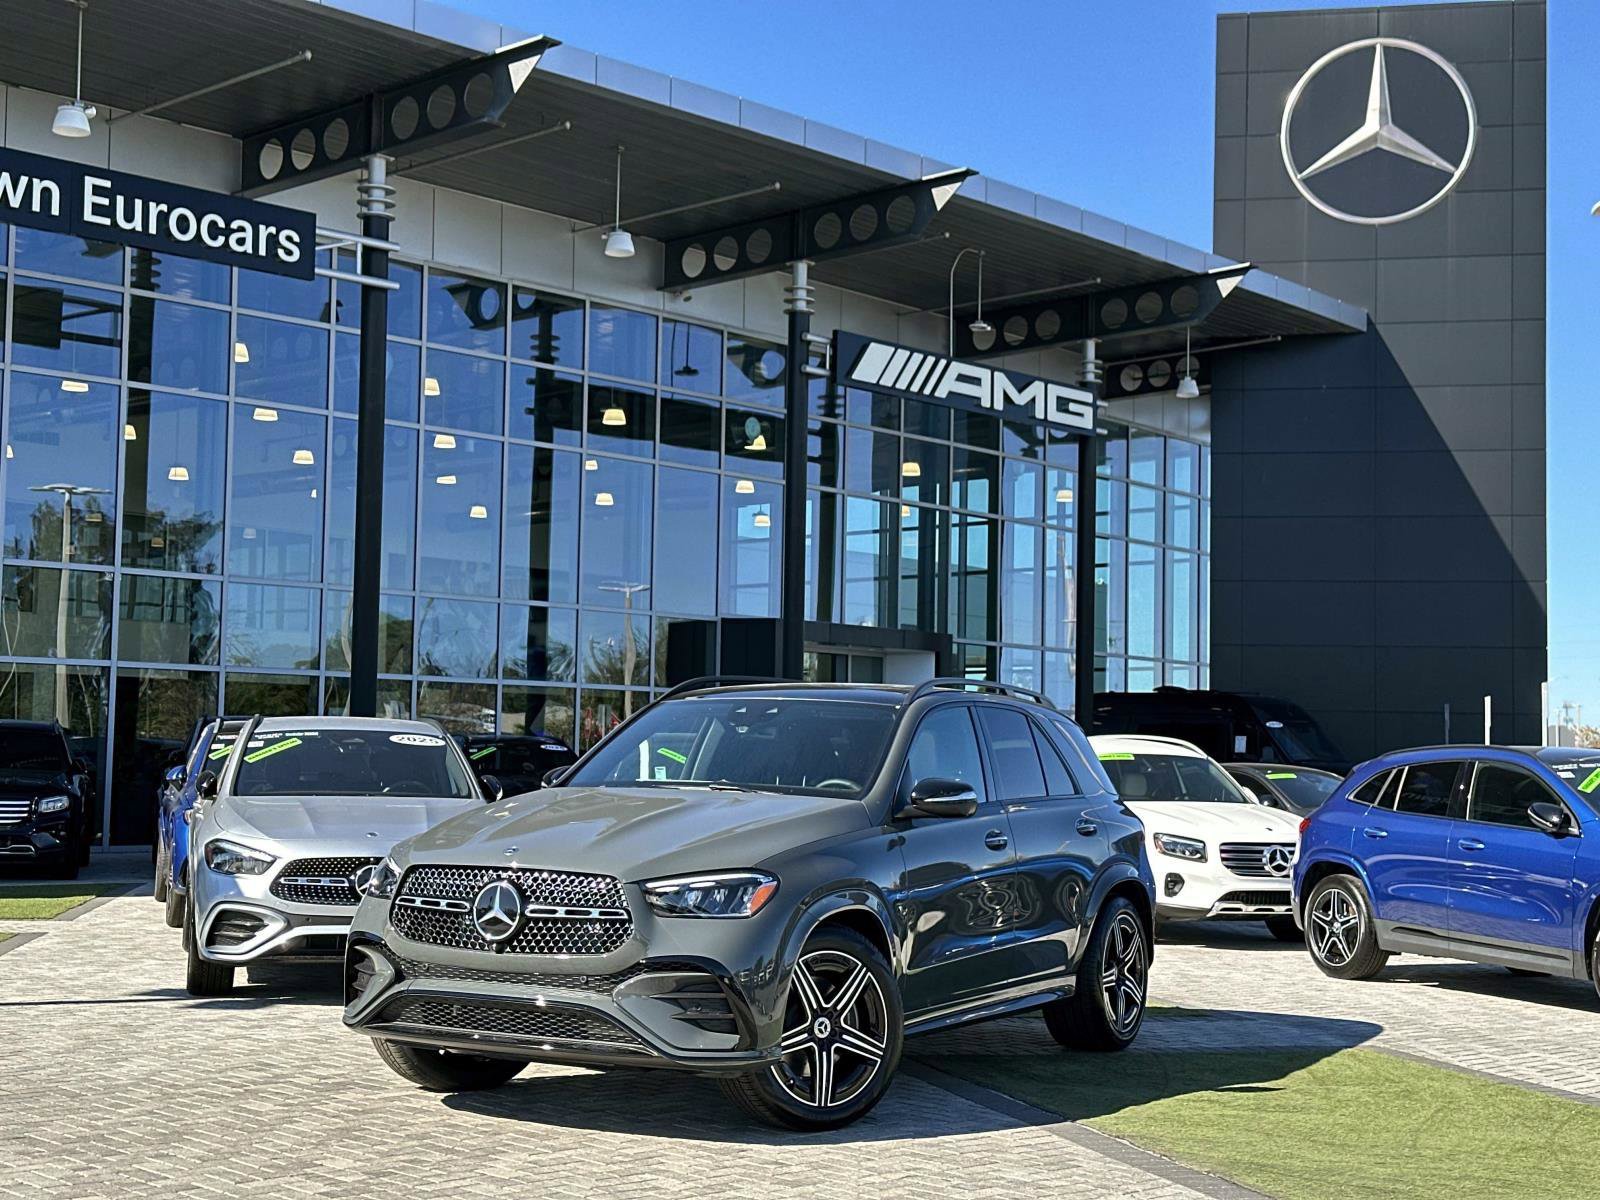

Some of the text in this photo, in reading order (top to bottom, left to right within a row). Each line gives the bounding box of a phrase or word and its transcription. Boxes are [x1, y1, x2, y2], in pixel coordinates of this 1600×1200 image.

[82, 174, 302, 264] Eurocars
[933, 361, 1095, 430] AMG
[395, 735, 439, 745] 2025
